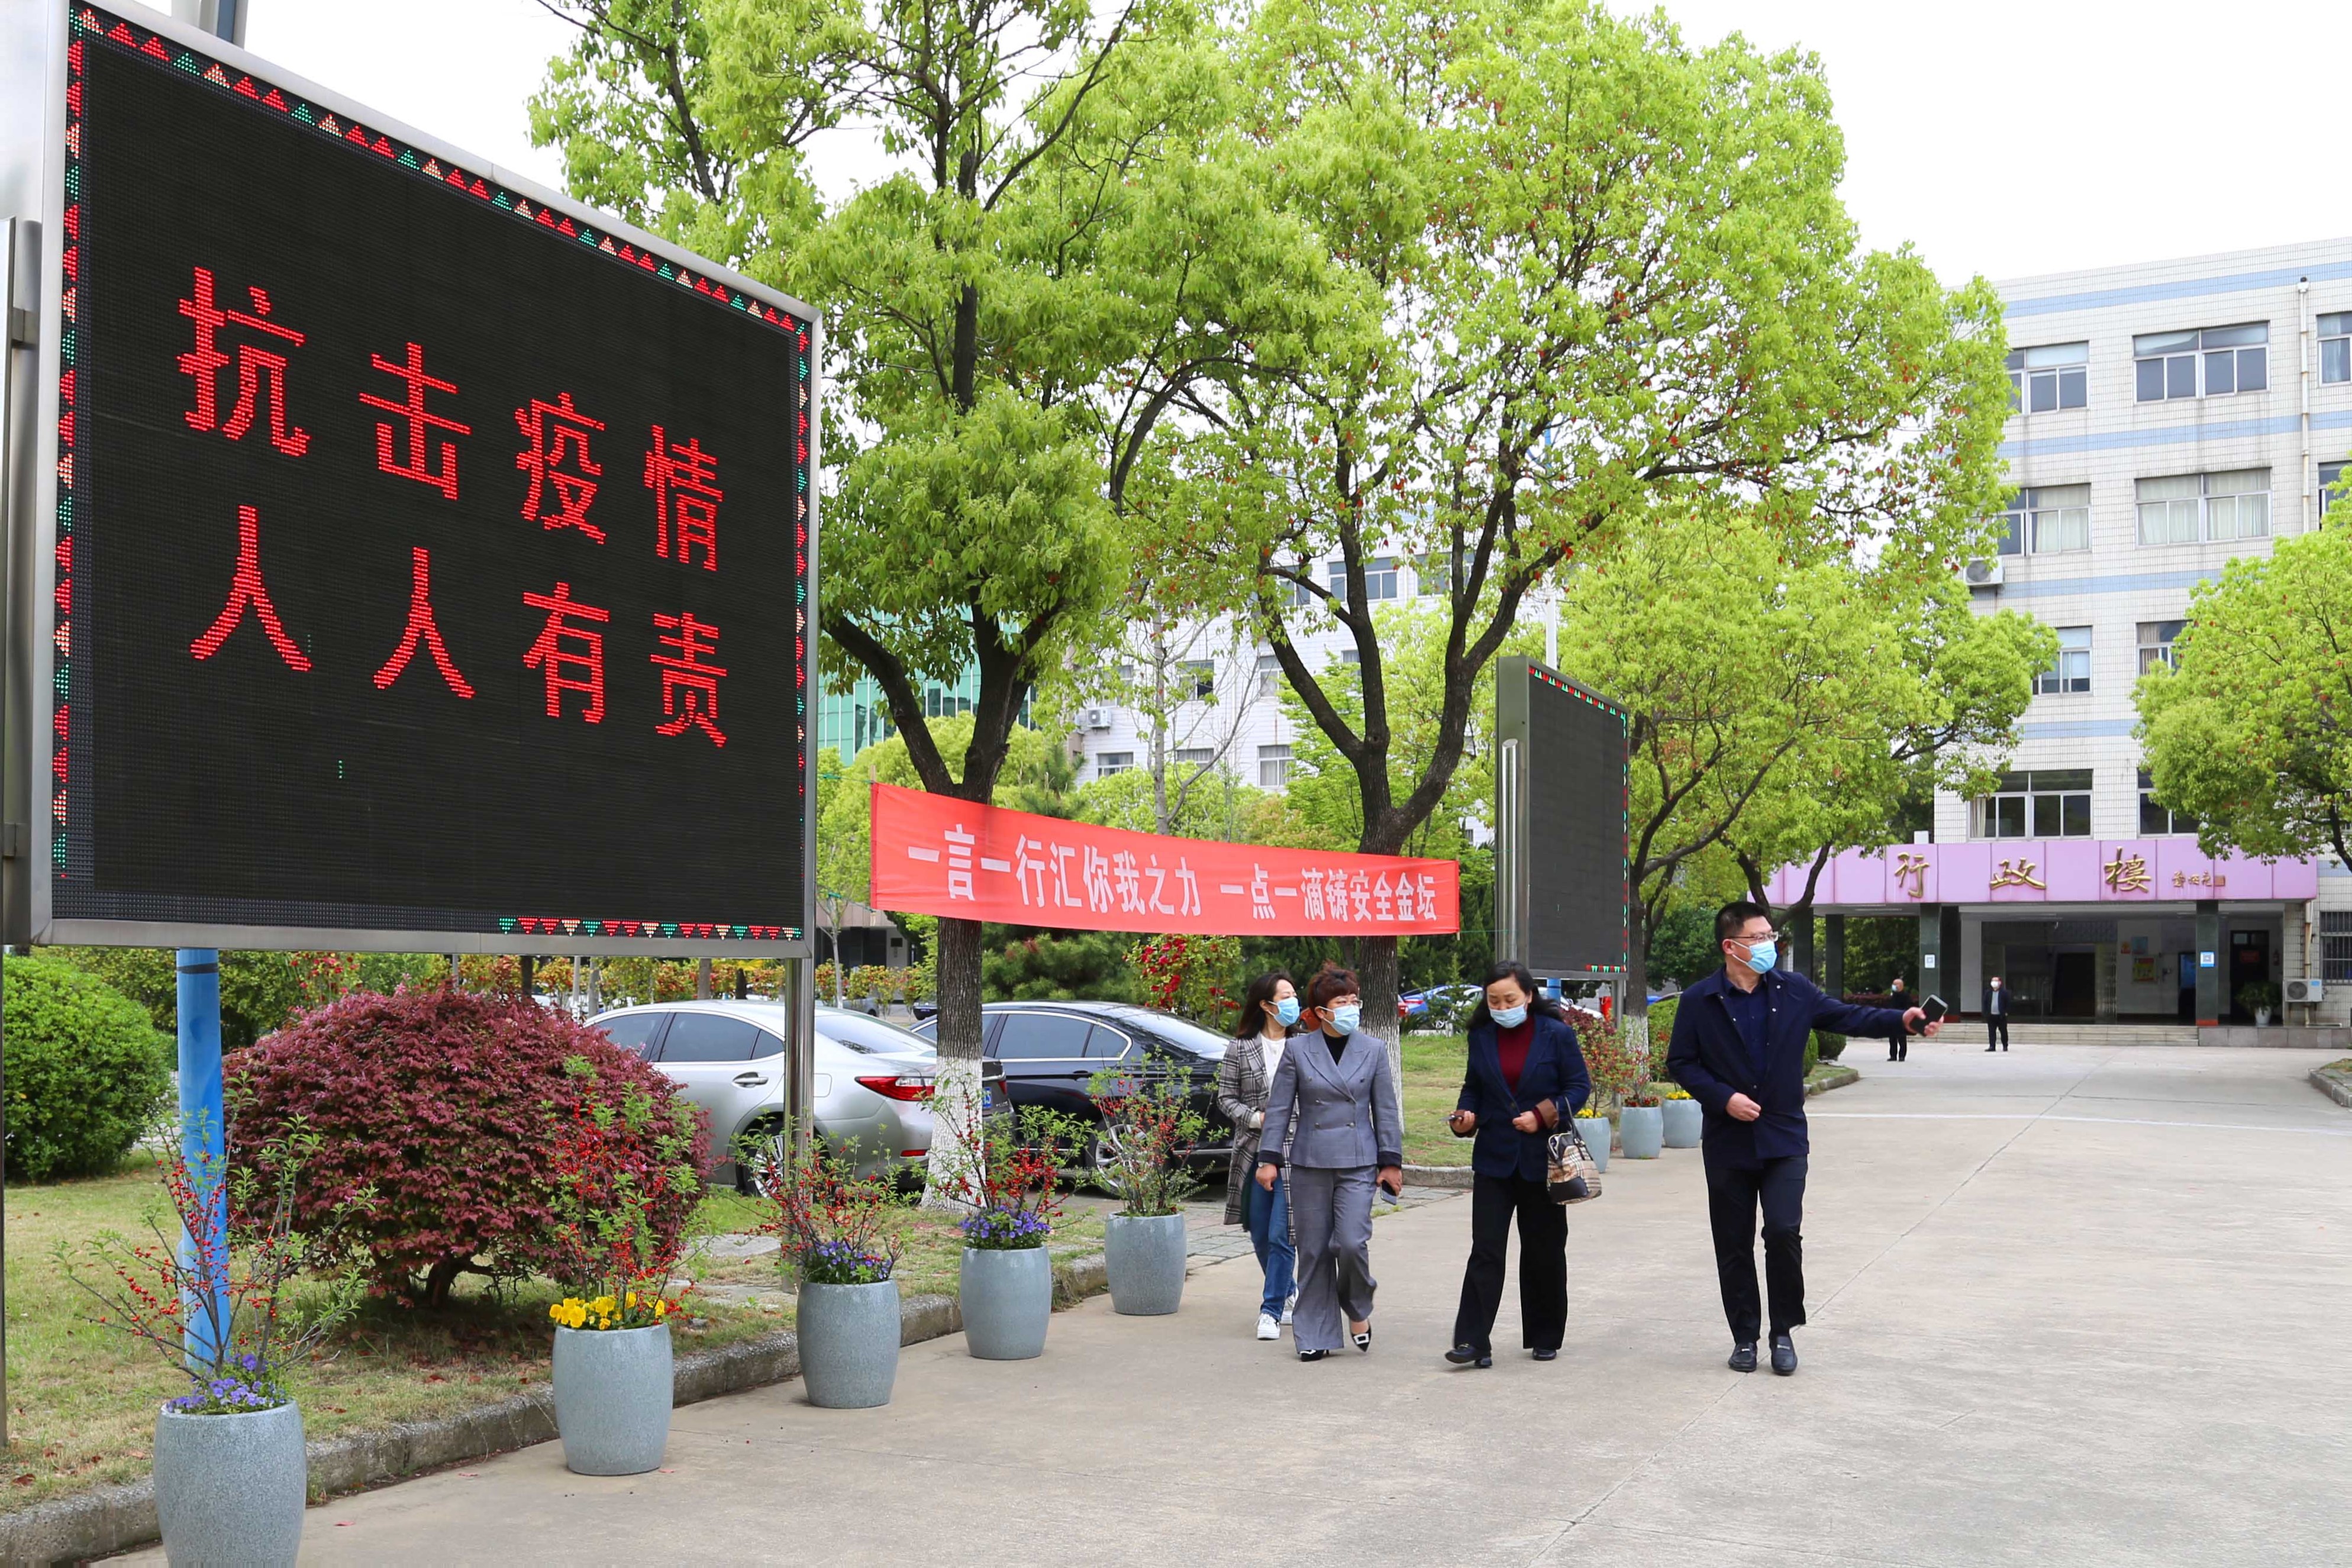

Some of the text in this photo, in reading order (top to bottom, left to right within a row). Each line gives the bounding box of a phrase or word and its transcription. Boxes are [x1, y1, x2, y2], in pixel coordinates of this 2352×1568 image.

[177, 267, 723, 570] 抗击疫情
[191, 506, 728, 747] 人人有责
[908, 822, 1437, 922] 一言一行汇你我之力 一点一滴铸安全金坛
